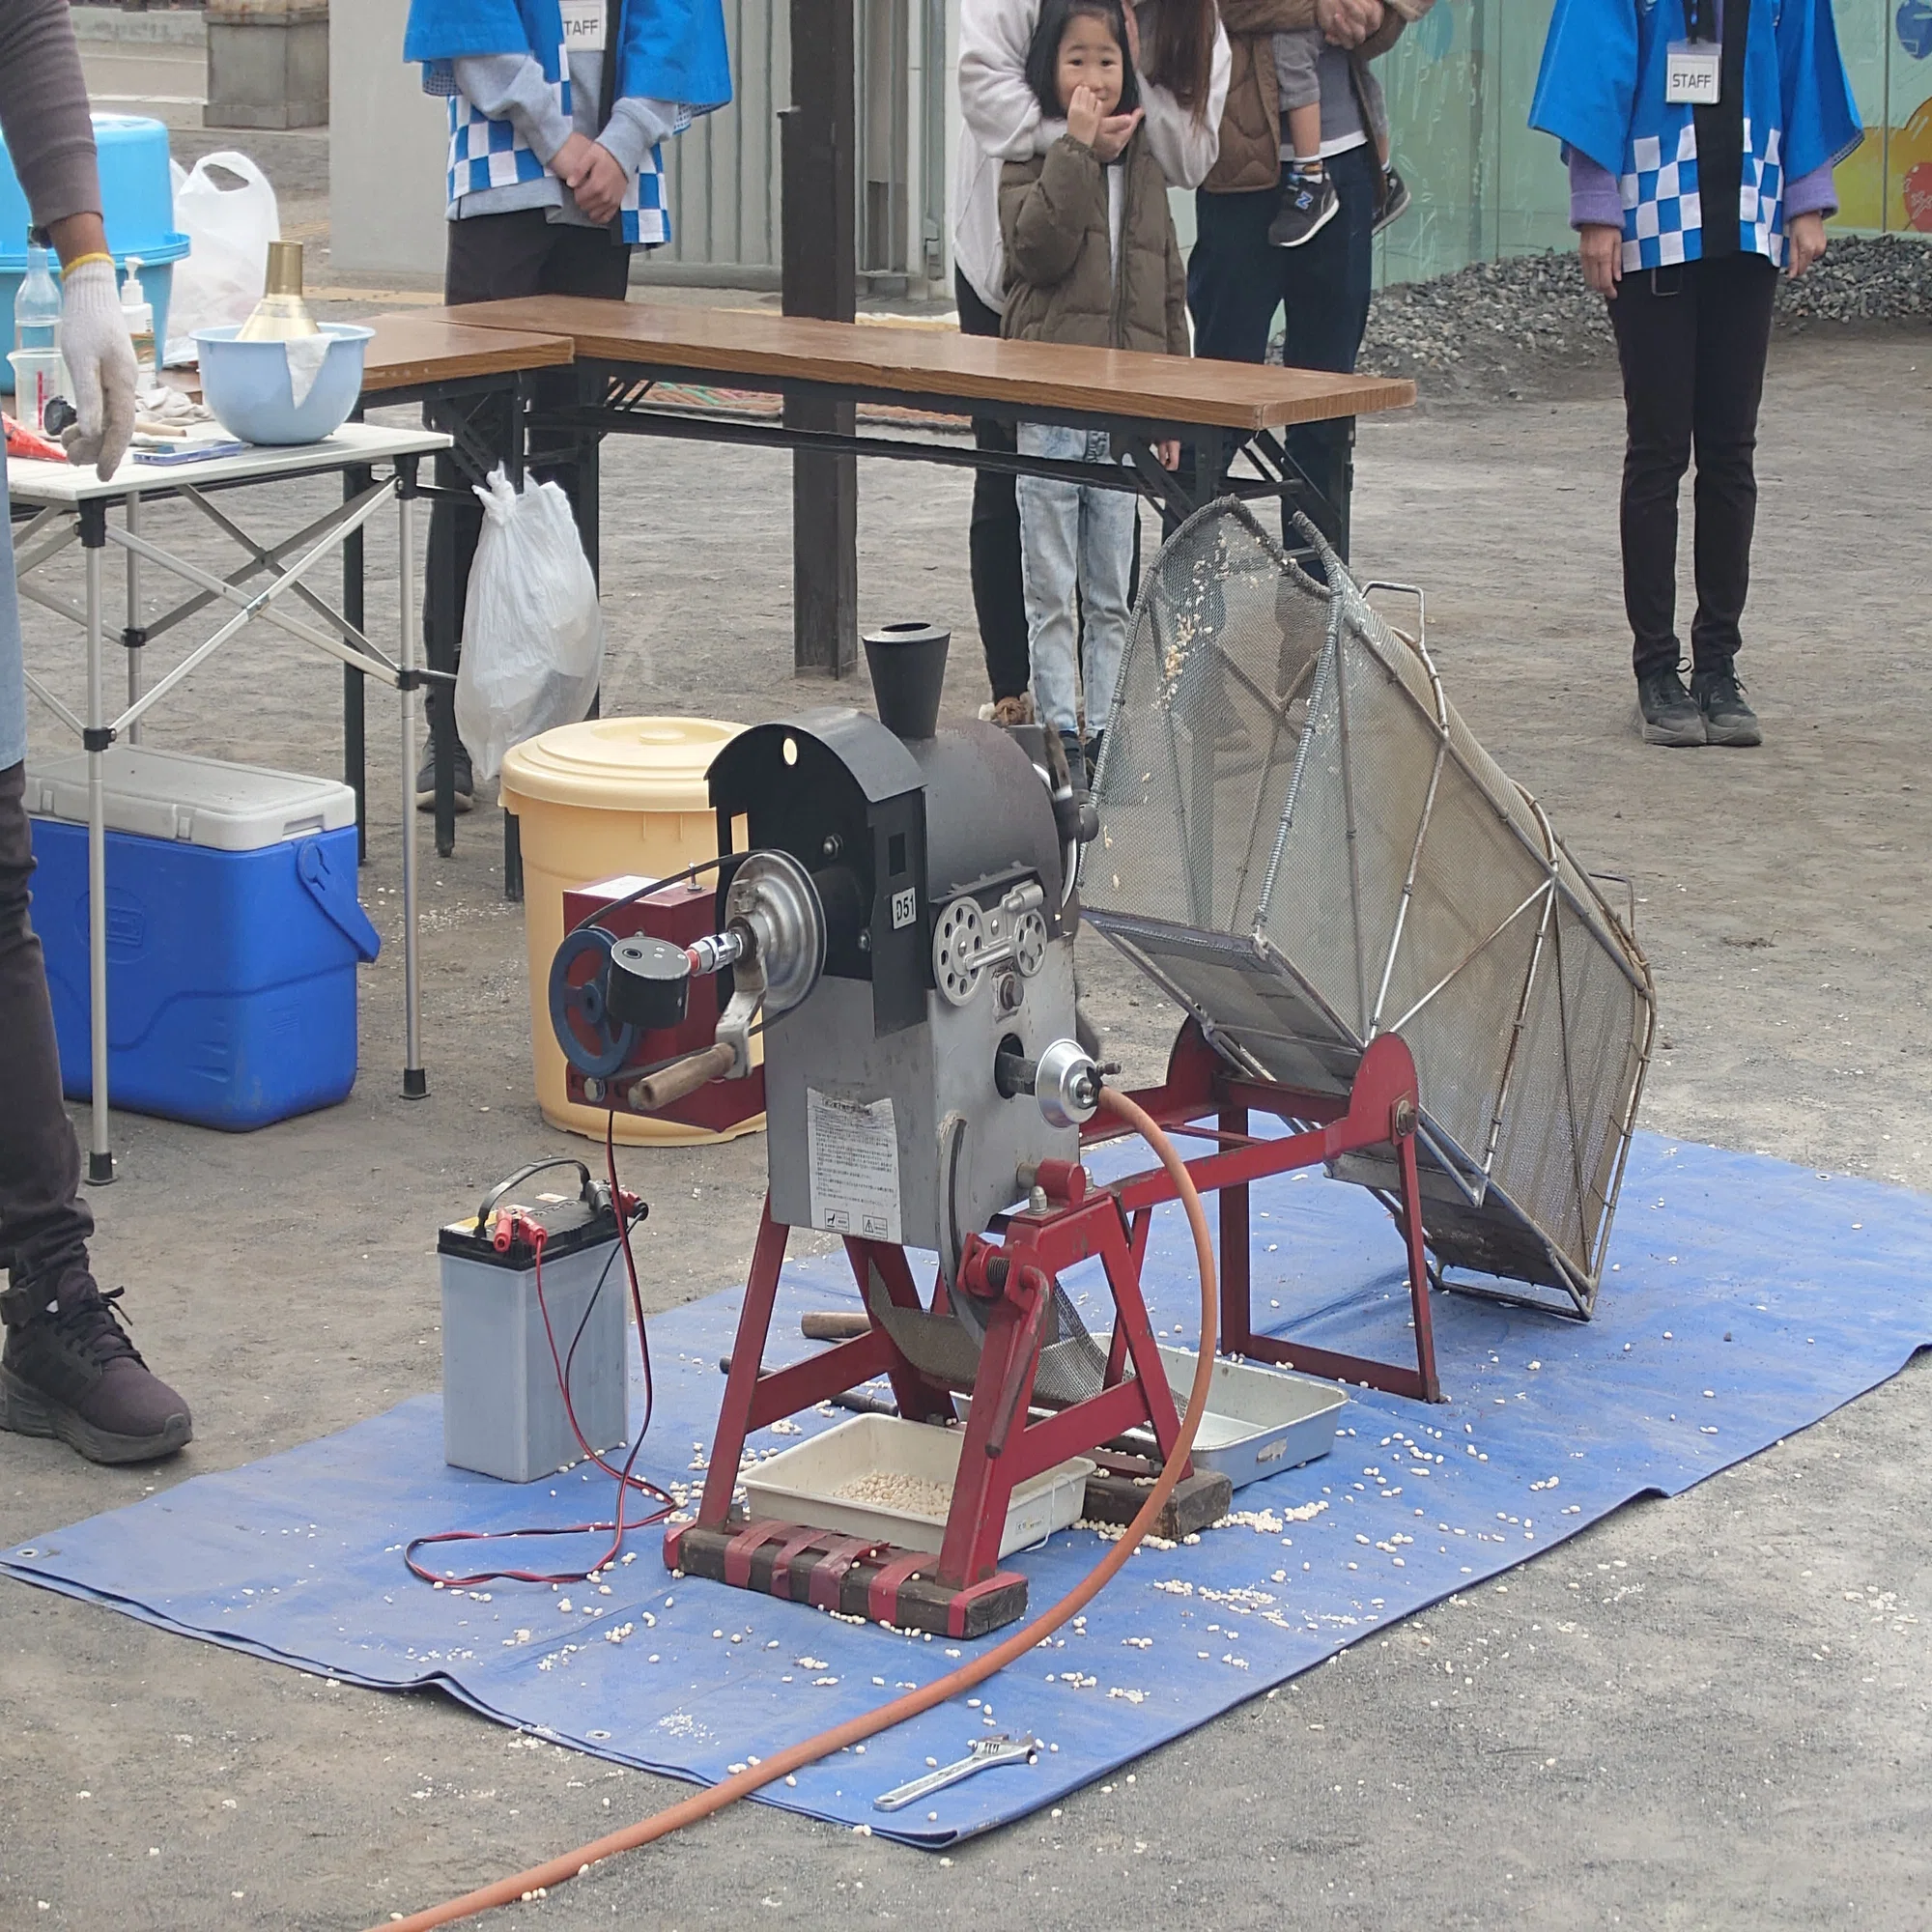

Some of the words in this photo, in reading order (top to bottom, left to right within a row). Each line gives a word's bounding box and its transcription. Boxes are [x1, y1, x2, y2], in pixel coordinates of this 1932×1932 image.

[563, 19, 599, 36] TAFF
[1672, 72, 1712, 89] STAFF
[895, 894, 915, 922] D51
